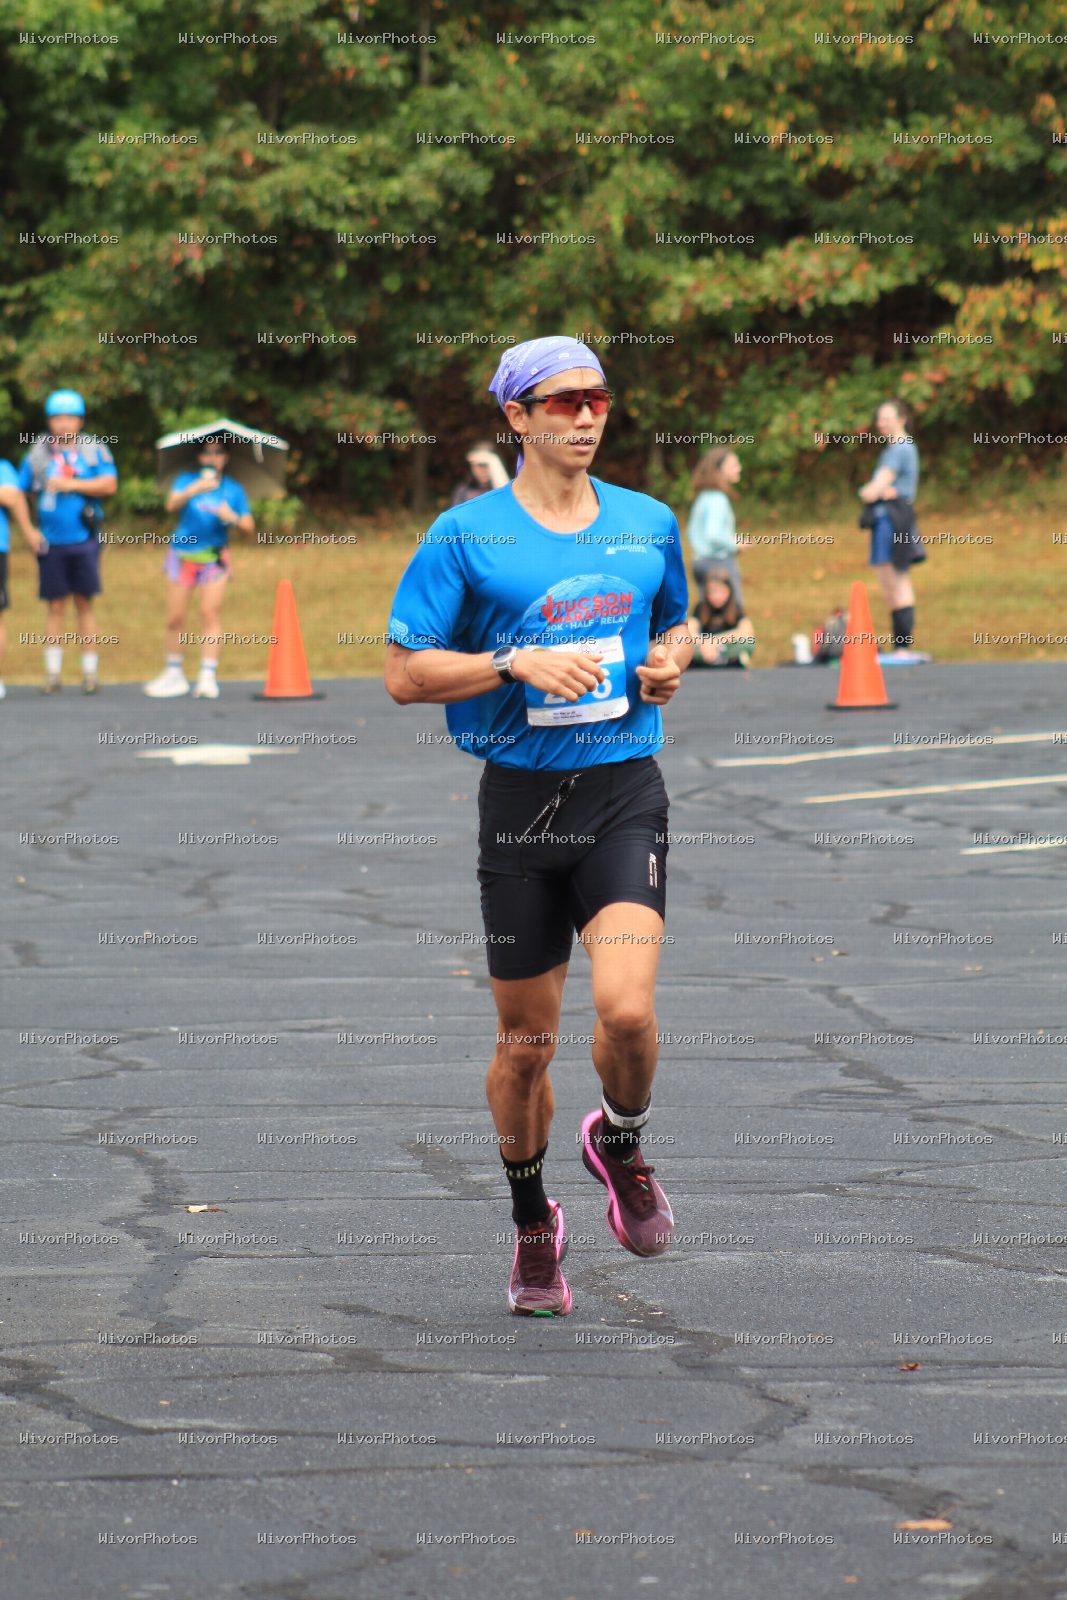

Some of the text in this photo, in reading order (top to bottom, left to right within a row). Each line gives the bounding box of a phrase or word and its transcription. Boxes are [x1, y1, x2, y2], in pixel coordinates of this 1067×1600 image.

[554, 592, 633, 614] TUCSON
[553, 604, 631, 624] MARATHON
[571, 619, 595, 629] HALF
[601, 615, 630, 625] RELAY
